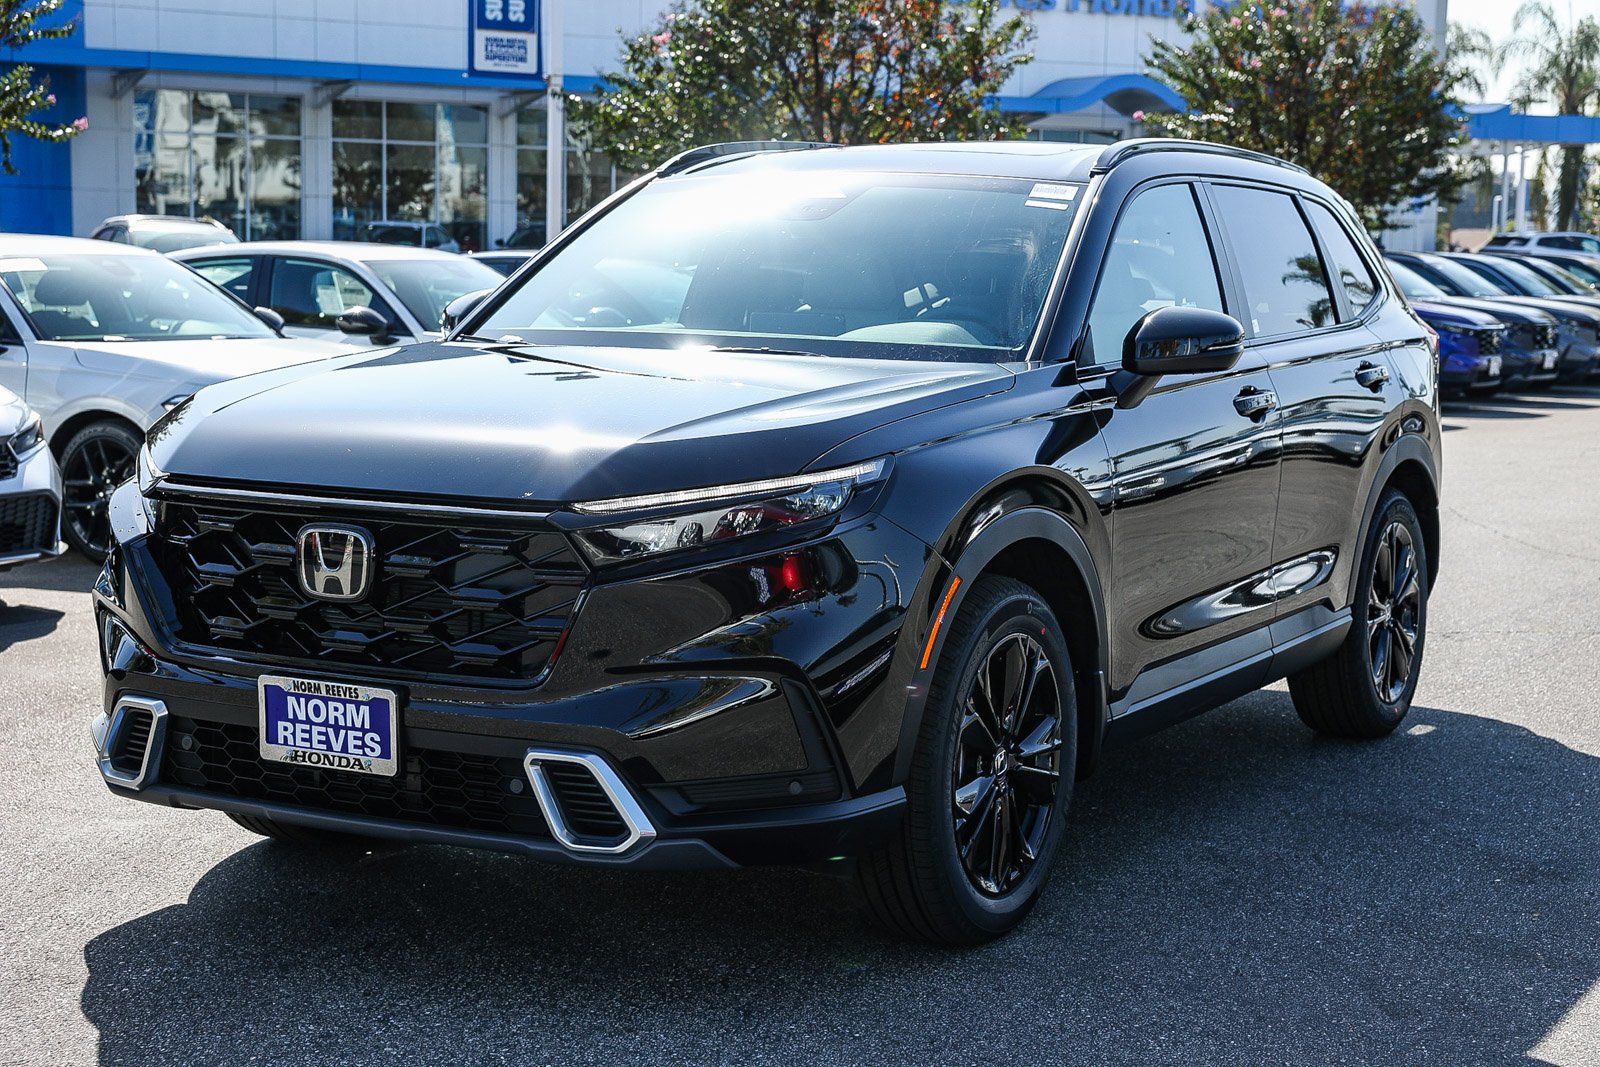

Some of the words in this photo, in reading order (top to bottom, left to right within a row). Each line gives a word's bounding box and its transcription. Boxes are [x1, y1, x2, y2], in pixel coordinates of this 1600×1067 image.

[292, 679, 322, 695] NORM
[325, 684, 359, 699] REEVES
[286, 695, 370, 729] NORM
[277, 720, 382, 758] REEVES
[292, 749, 366, 771] HONDA
